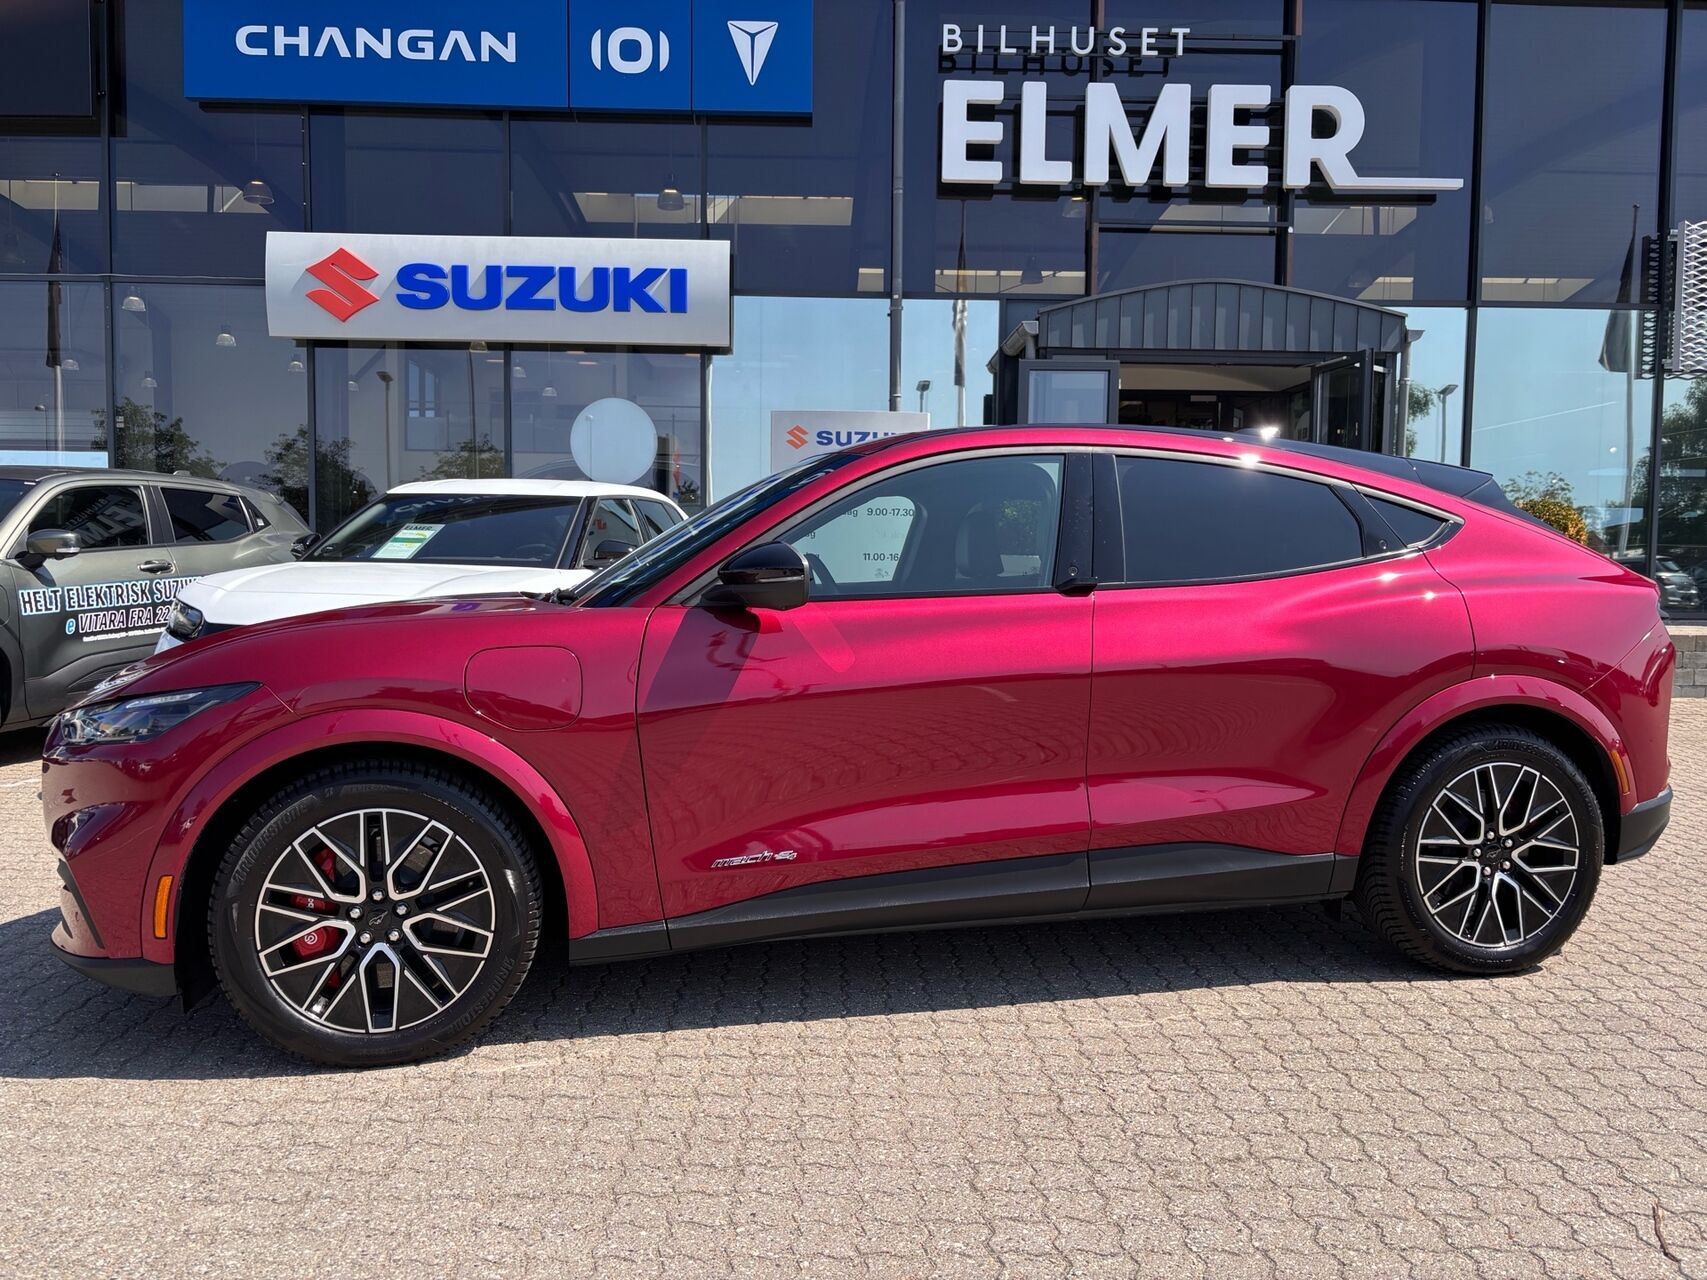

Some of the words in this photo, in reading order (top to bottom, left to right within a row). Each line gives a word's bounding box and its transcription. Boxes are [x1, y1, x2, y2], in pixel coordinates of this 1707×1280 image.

[236, 26, 517, 64] CHANGAN
[942, 24, 1191, 56] BILHUSET
[941, 80, 1464, 190] ELMER
[396, 262, 690, 314] SUZUKI
[19, 589, 62, 616] HELT
[65, 581, 152, 610] ELEKTRISK
[153, 577, 202, 601] SUZ
[65, 617, 77, 635] e
[78, 610, 127, 633] VITARA
[128, 606, 153, 627] FRA
